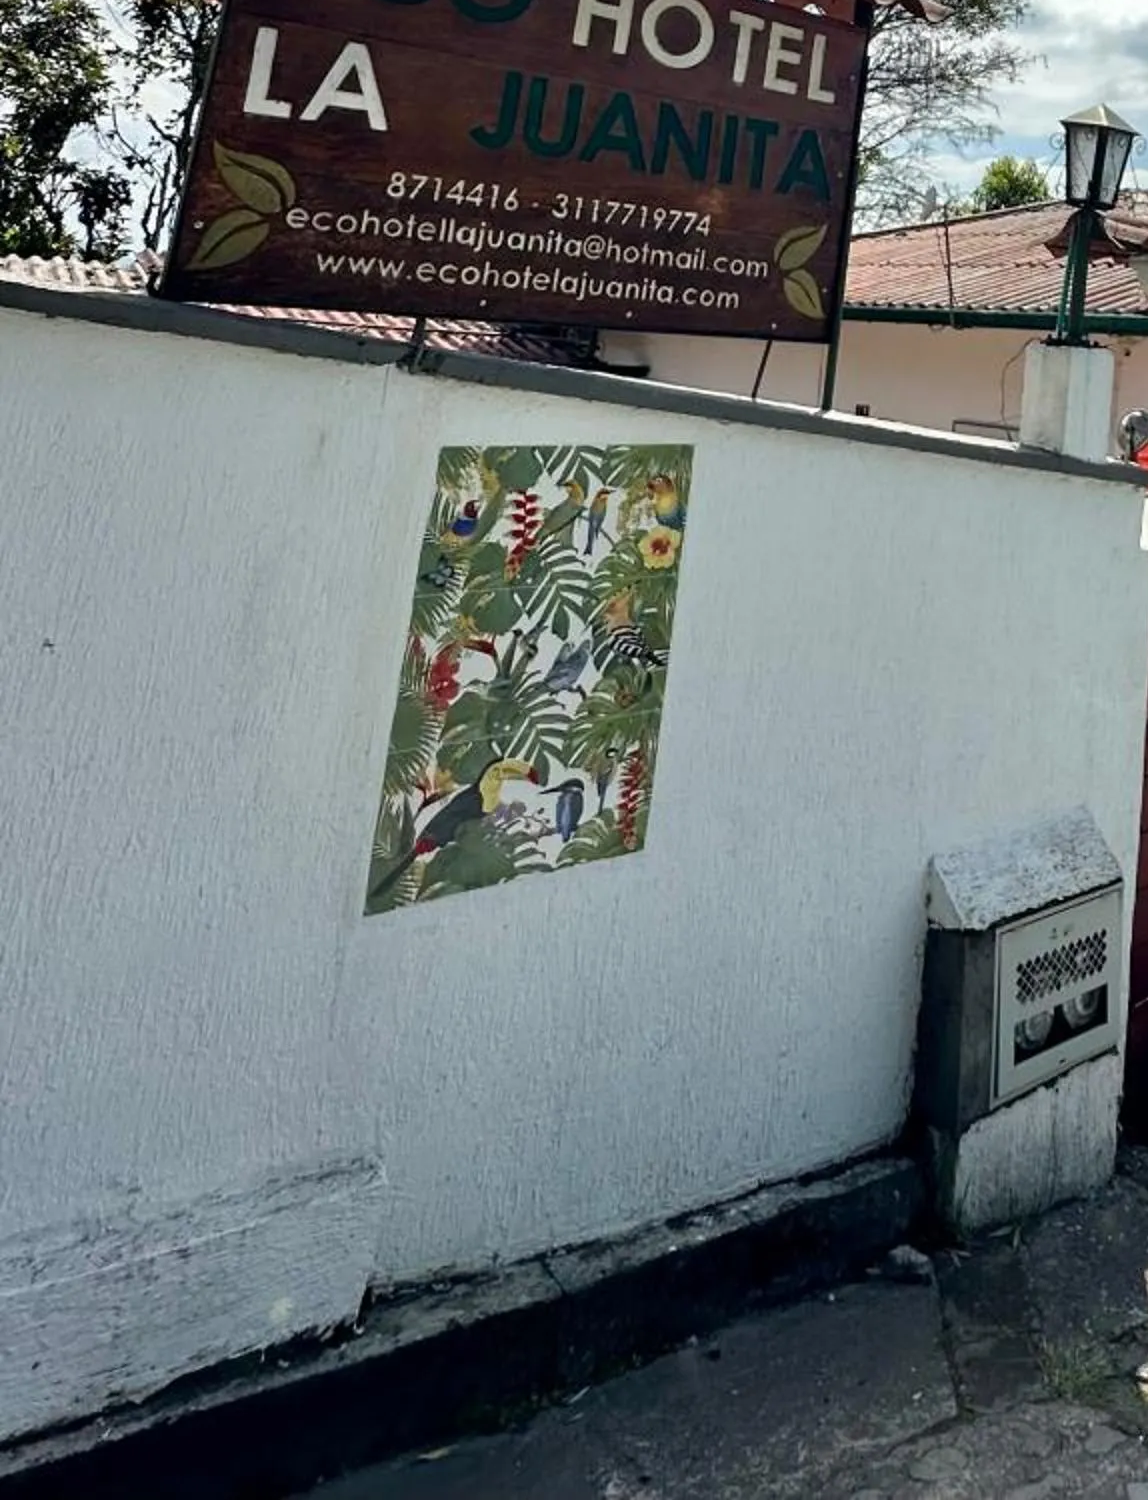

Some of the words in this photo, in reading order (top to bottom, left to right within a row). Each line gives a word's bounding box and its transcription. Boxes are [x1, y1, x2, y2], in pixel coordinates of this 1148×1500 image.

[243, 25, 389, 132] LA
[469, 70, 834, 202] JUANITA
[386, 171, 520, 212] 8714416
[551, 192, 713, 237] 3117719774
[285, 206, 769, 278] ecohotellajuanita@hotmail.com
[316, 252, 741, 309] www.ecohotelajuanita.com
